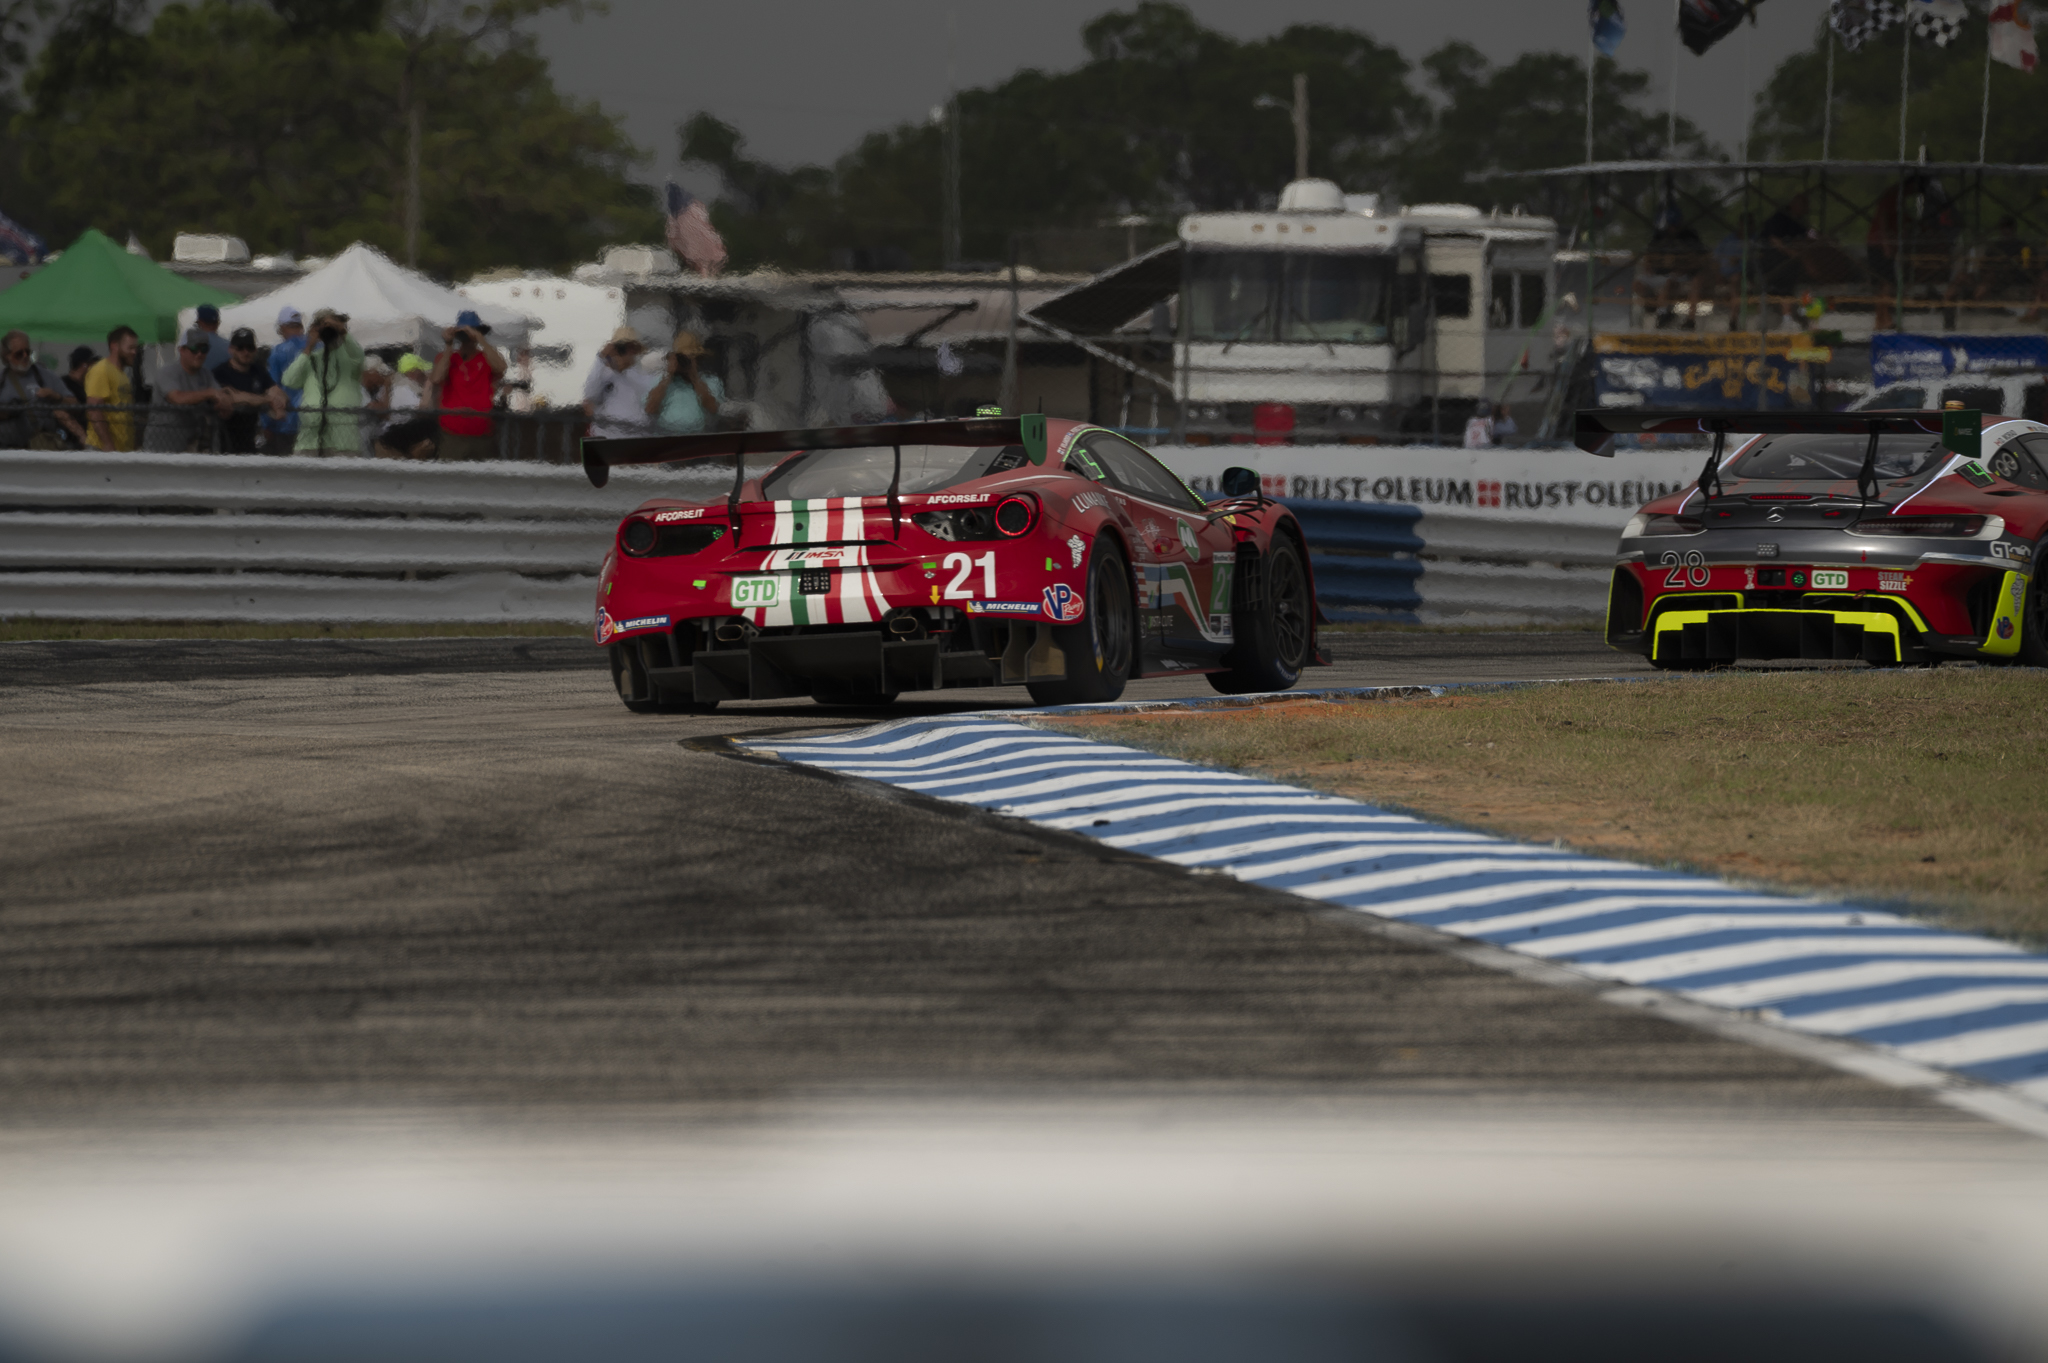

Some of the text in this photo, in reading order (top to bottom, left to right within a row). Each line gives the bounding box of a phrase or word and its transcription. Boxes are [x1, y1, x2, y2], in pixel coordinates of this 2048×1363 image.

[926, 493, 991, 505] AFCORSE.IT
[654, 508, 705, 523] AFCORSE.IT
[804, 550, 845, 560] IMSA
[1989, 540, 2012, 559] GT
[942, 550, 997, 600] 21
[1659, 549, 1711, 588] 28
[1814, 573, 1847, 587] GTD
[1877, 571, 1904, 582] STEAK
[735, 580, 776, 602] GTD
[1213, 566, 1233, 611] 21
[1879, 580, 1907, 591] SIZZLE
[985, 603, 1039, 612] MICHELIN
[1042, 583, 1072, 620] VP
[625, 616, 667, 628] MICHELIN
